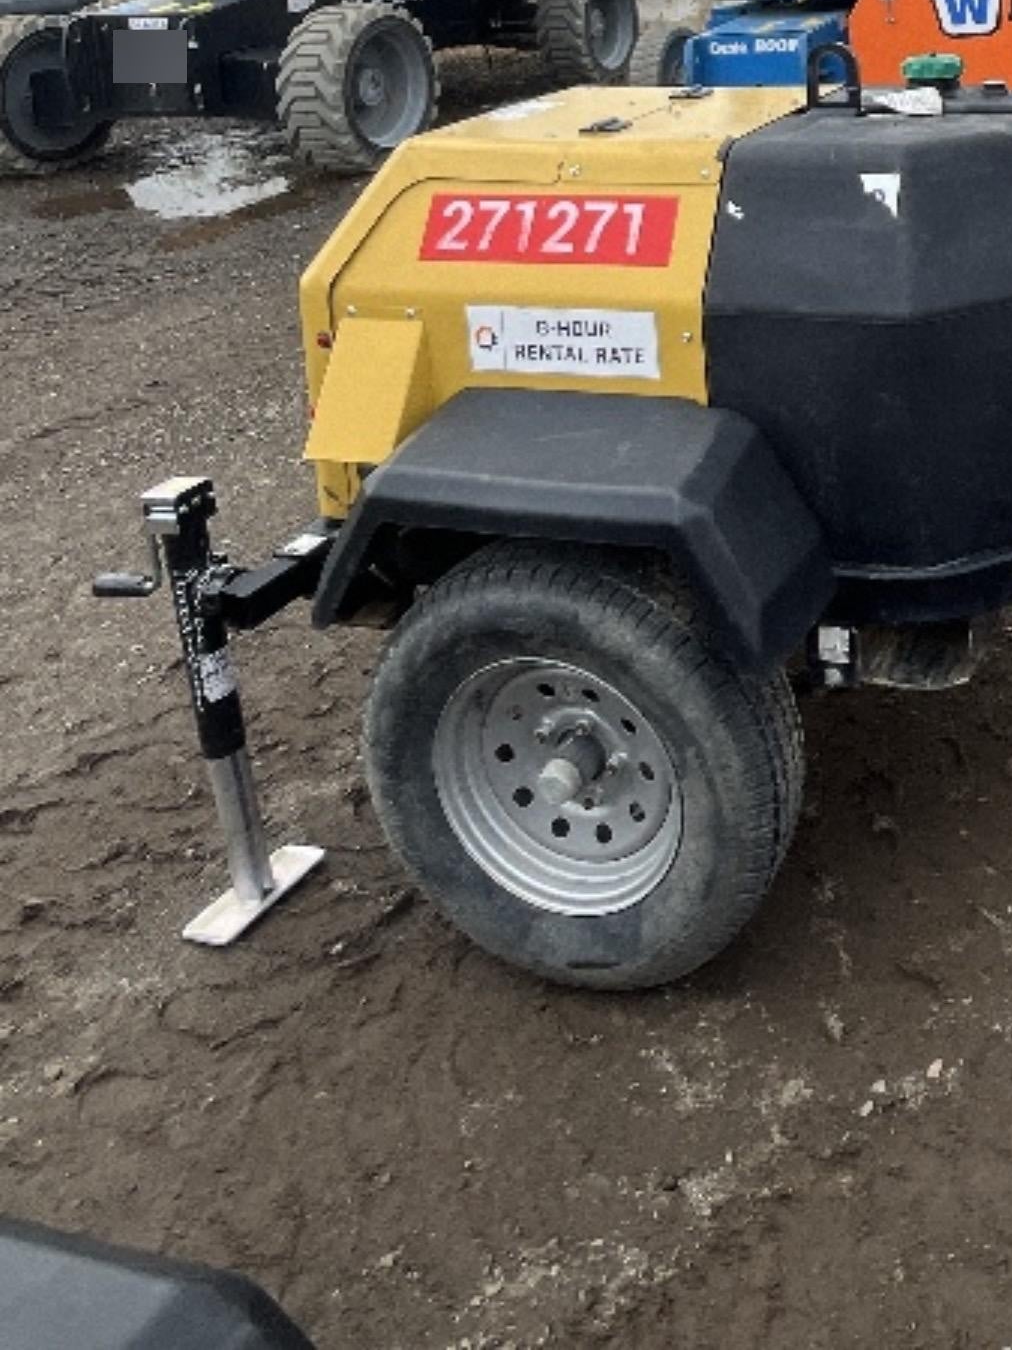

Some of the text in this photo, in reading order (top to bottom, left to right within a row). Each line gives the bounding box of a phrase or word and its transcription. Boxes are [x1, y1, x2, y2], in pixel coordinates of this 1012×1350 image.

[436, 199, 646, 256] 271271
[515, 344, 646, 365] RENTAL RATE
